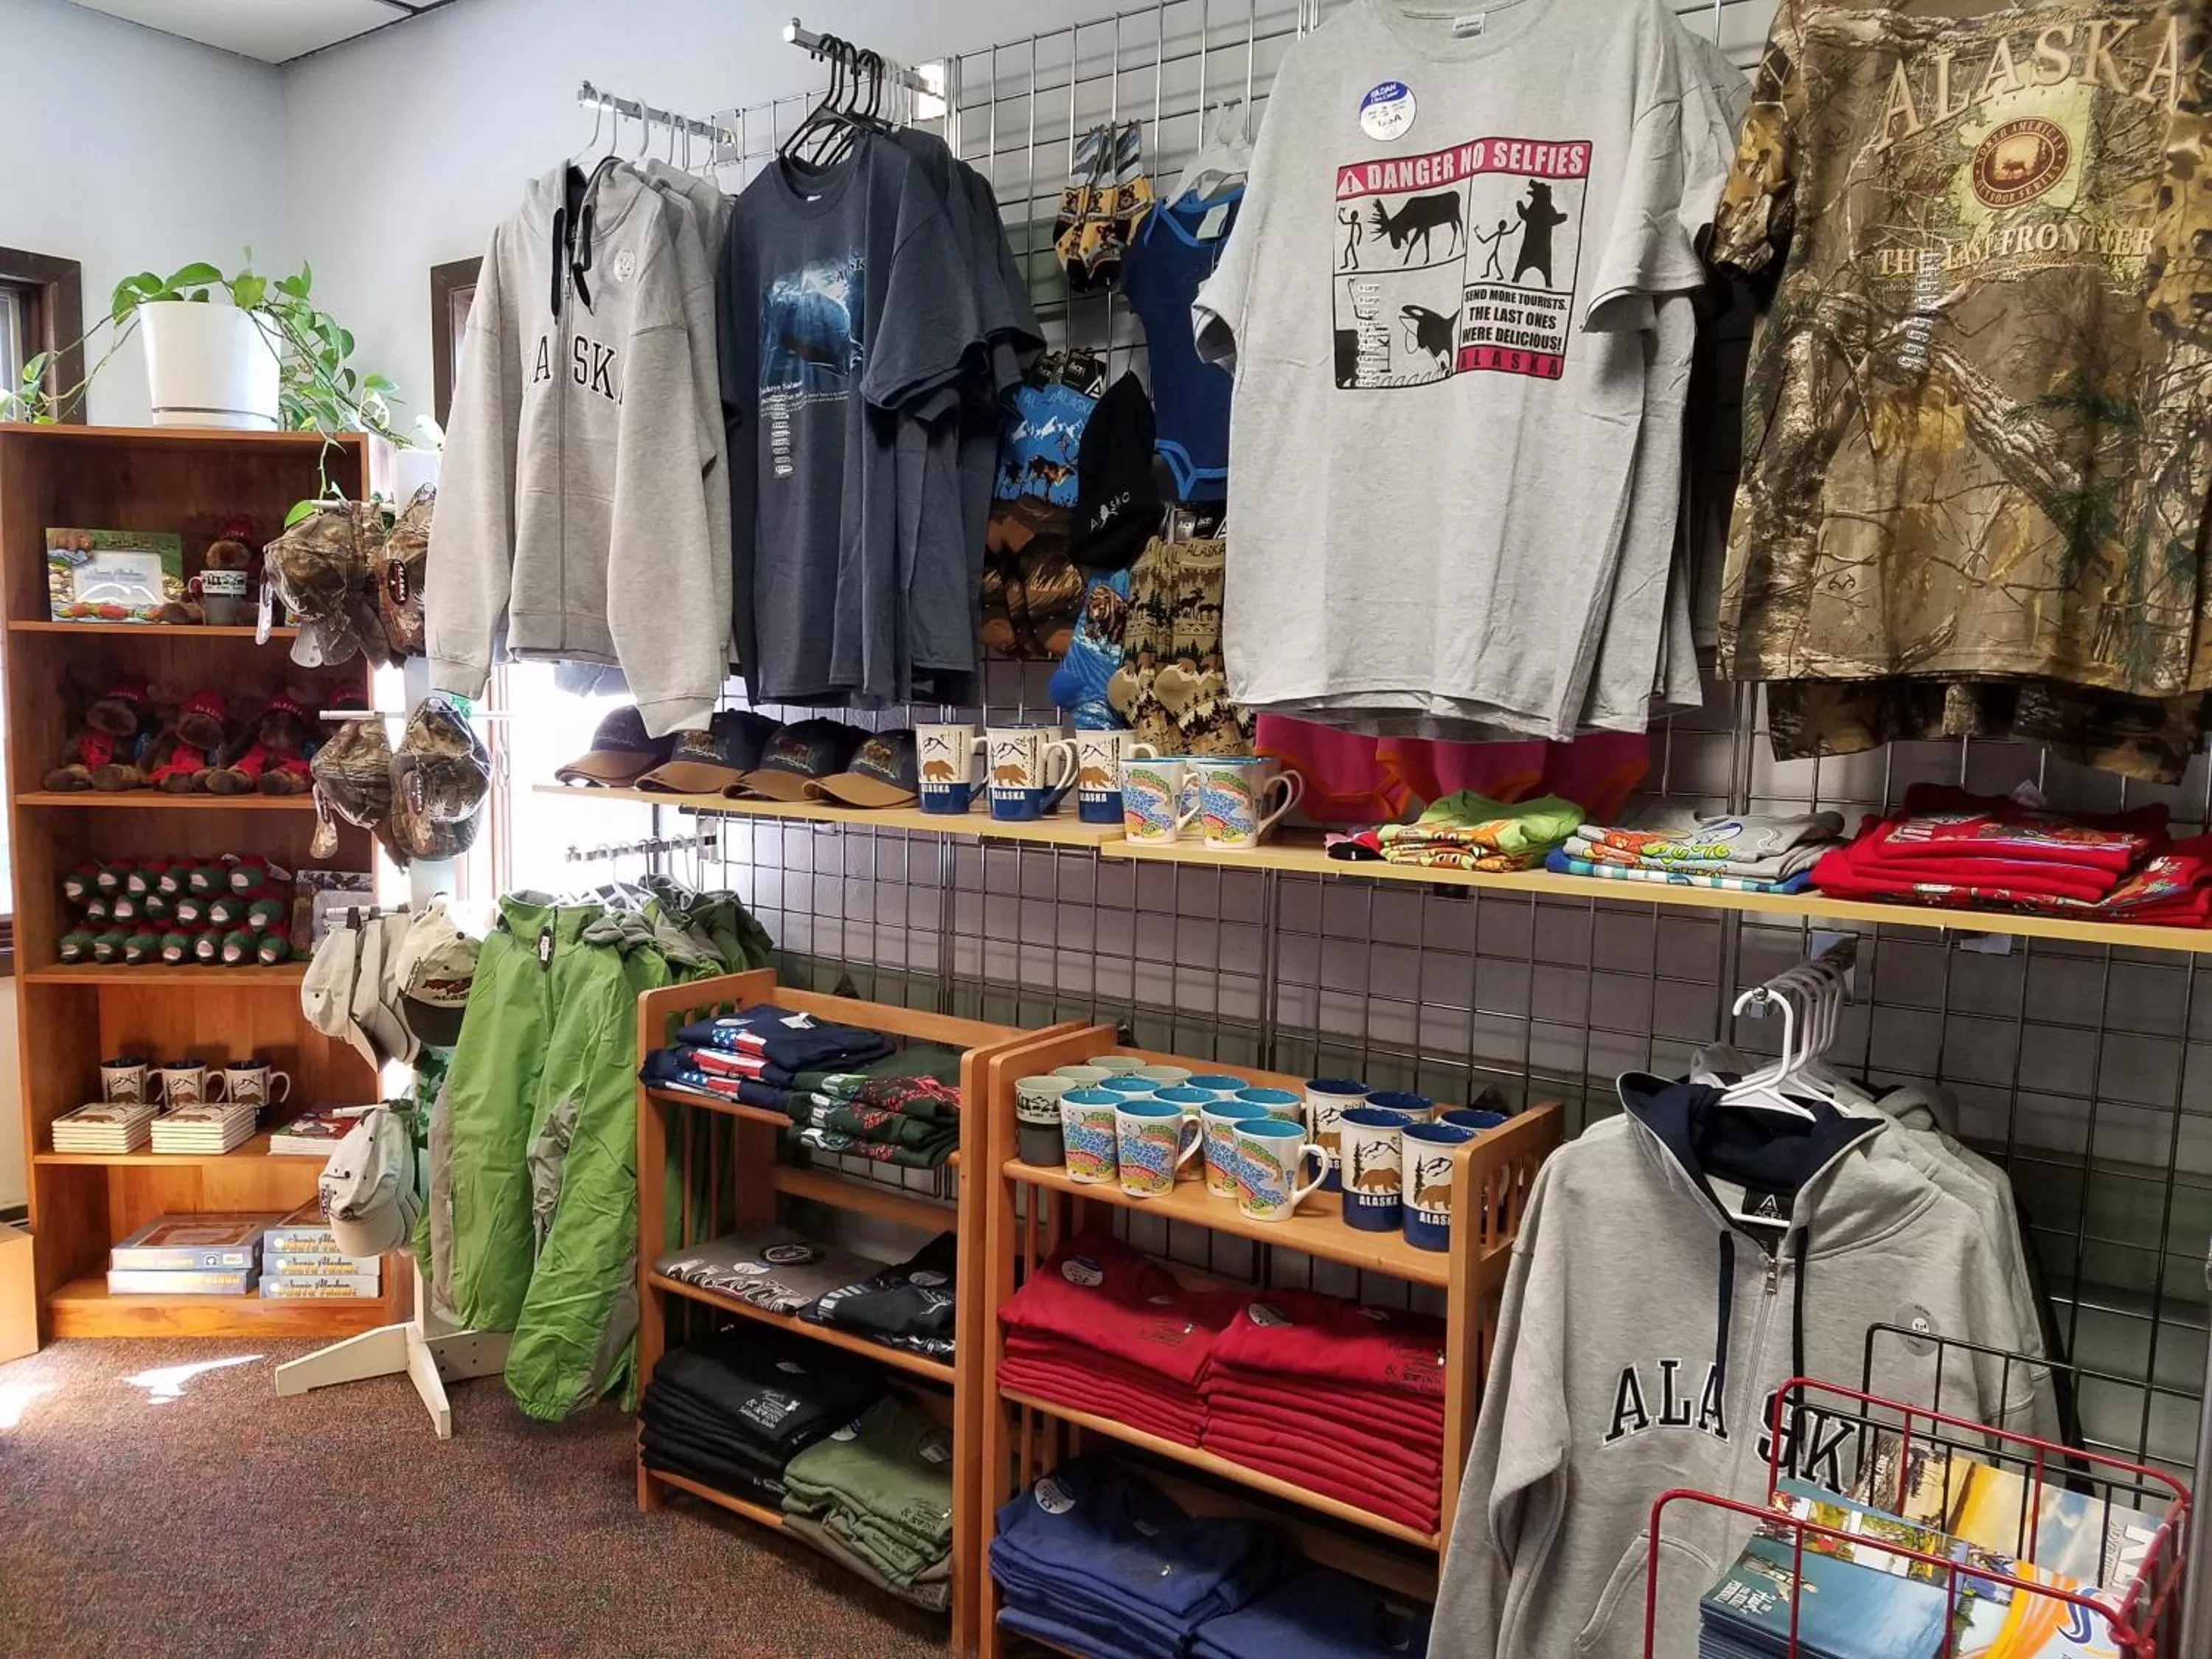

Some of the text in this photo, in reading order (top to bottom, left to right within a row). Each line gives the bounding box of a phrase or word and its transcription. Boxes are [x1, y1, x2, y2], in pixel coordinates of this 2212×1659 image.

[1874, 16, 2181, 155] ALASKA
[1367, 142, 1585, 189] DANGER NO SELFIES
[1945, 232, 1994, 271] LAST
[2000, 223, 2154, 257] FRONTIER
[1465, 288, 1568, 310] SEND MORE TOURISTS.
[1470, 306, 1557, 330] THE LAST ONES
[1462, 327, 1562, 350] WERE DELICIOUS!
[1460, 349, 1559, 376] ALASKA
[1359, 1195, 1399, 1208] ALASKA
[1419, 1211, 1451, 1226] ALAS
